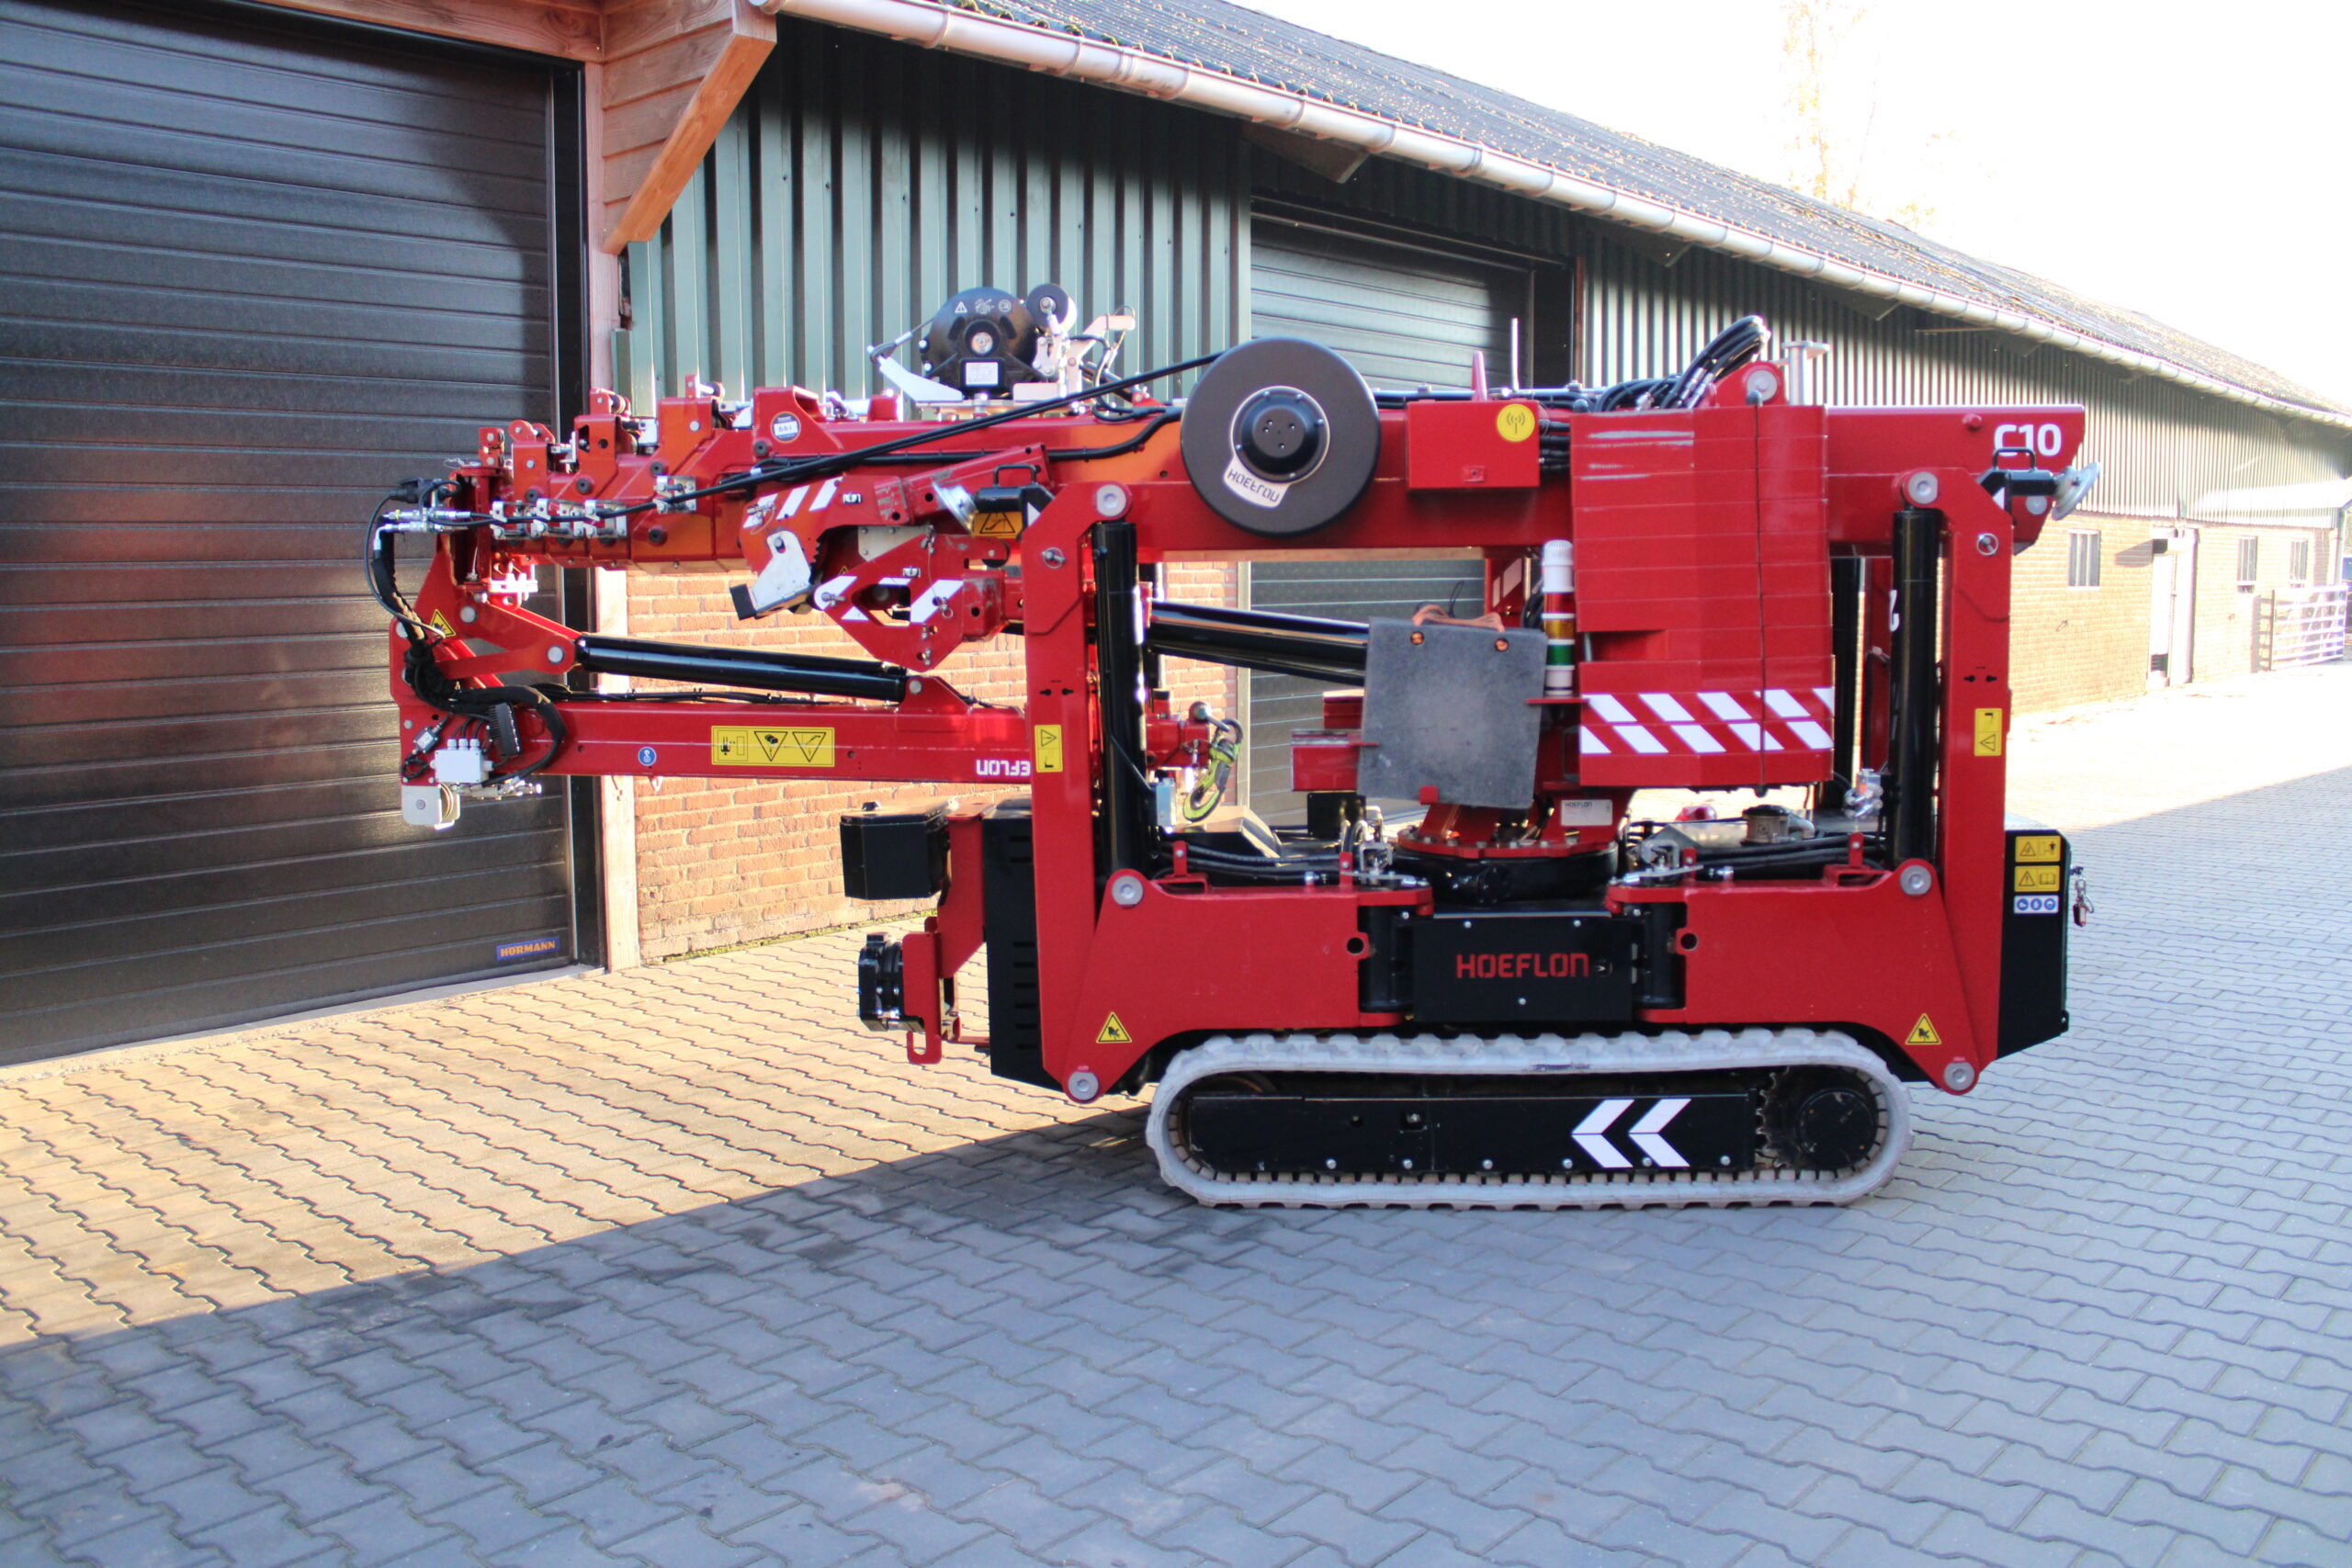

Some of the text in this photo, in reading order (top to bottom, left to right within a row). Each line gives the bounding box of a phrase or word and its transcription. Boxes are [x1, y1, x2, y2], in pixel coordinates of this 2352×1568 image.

[1994, 423, 2062, 457] C10
[976, 759, 1031, 776] EFLON
[1456, 953, 1589, 978] HOEFLON
